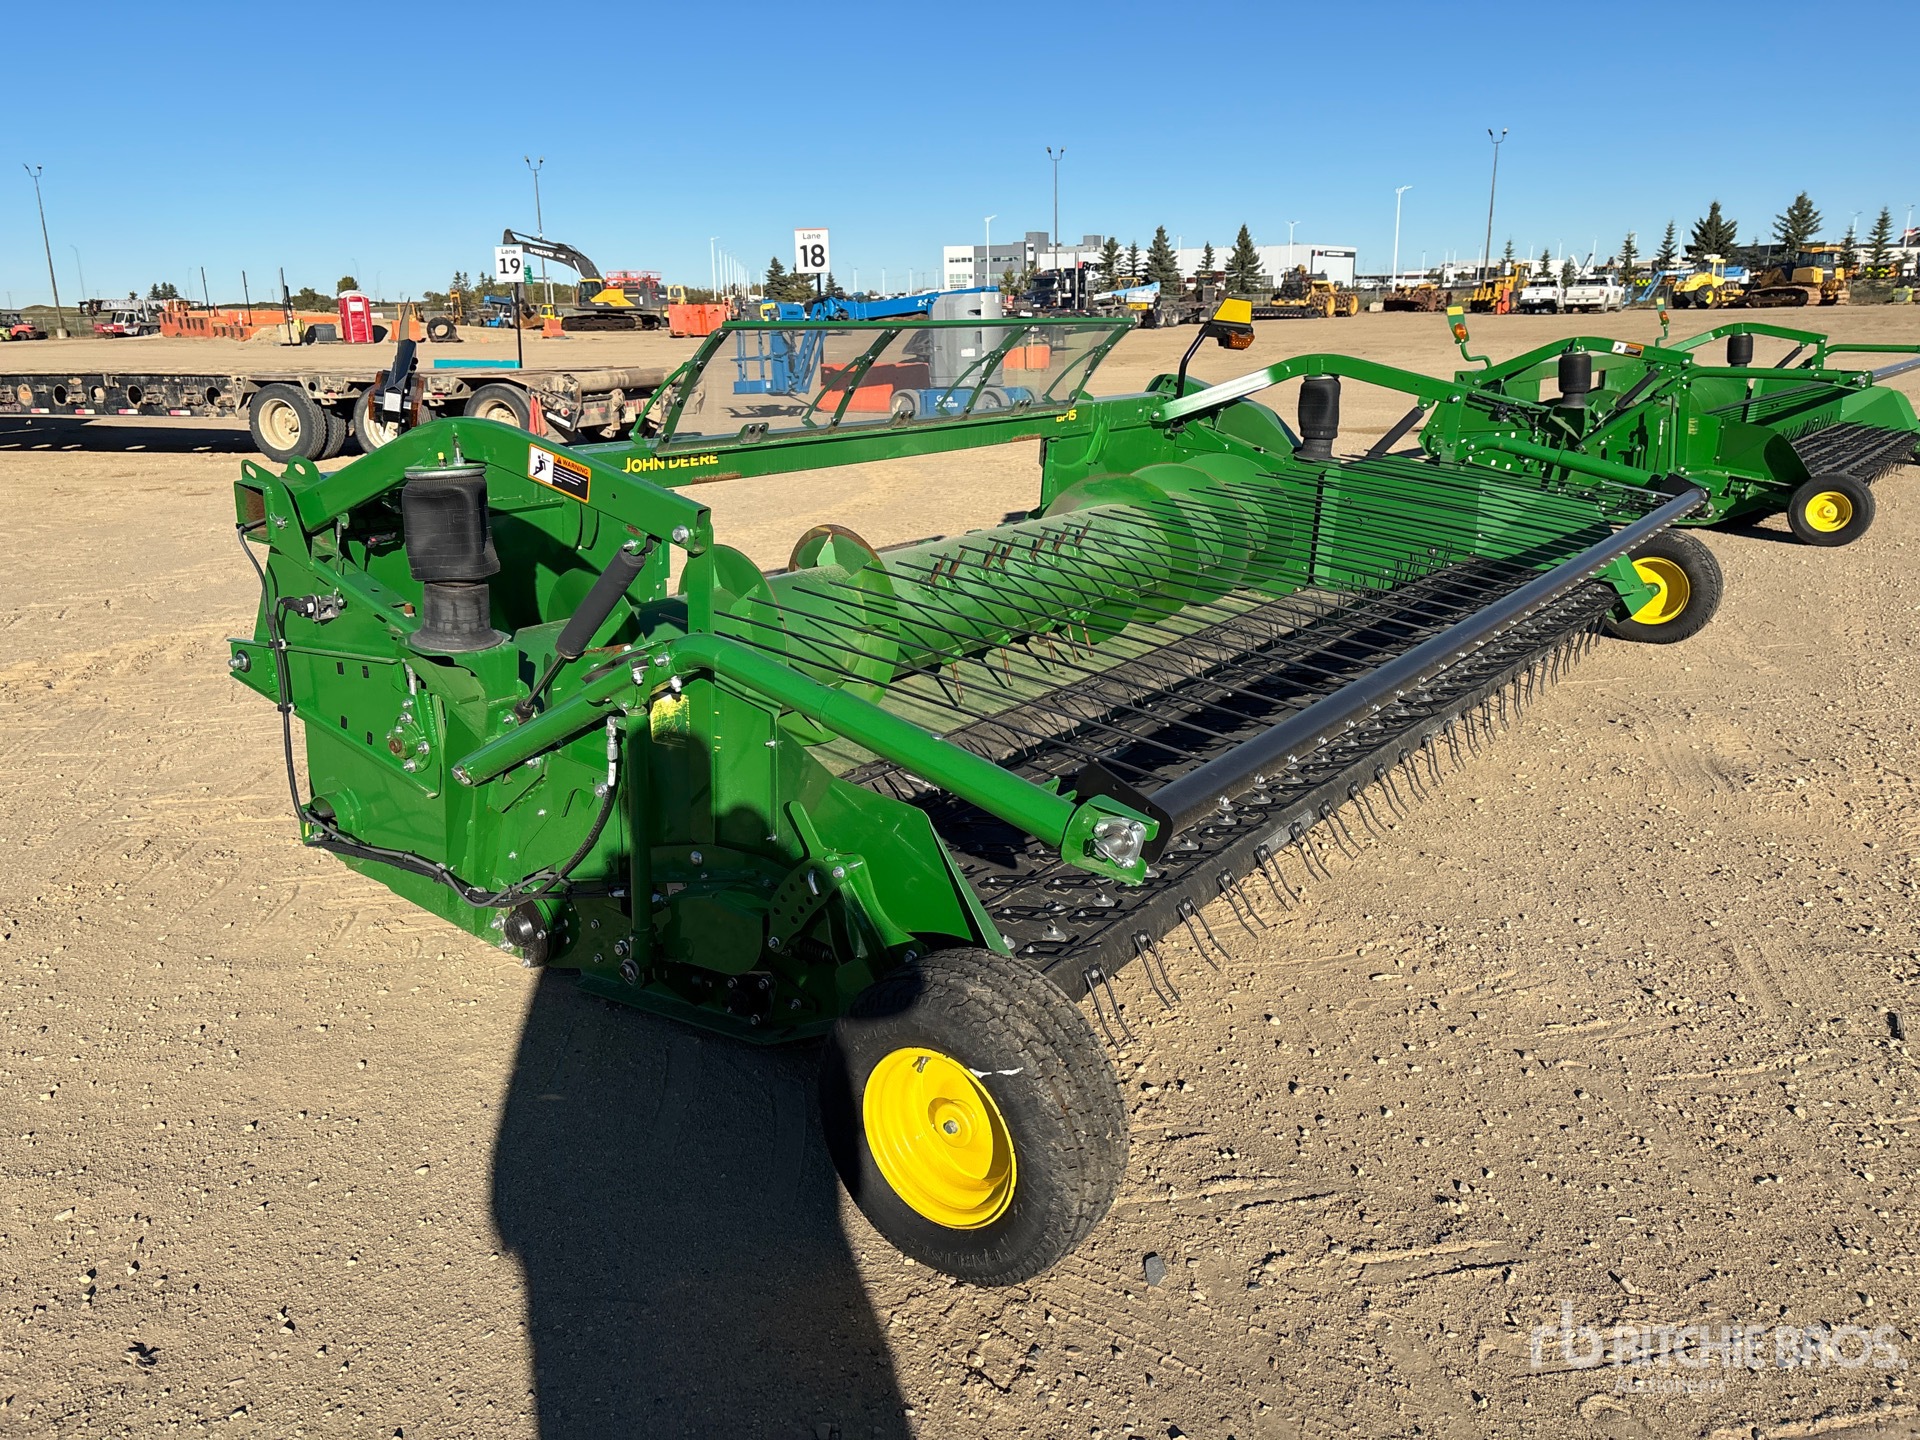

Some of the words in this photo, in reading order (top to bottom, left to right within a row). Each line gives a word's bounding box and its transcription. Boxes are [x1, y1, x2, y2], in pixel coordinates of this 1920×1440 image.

[802, 232, 821, 240] Lane
[528, 247, 554, 257] VOLVO
[799, 244, 826, 268] 18
[499, 257, 521, 275] 19
[562, 459, 588, 475] WARNING
[621, 457, 665, 473] JOHN
[668, 452, 719, 469] DEERE
